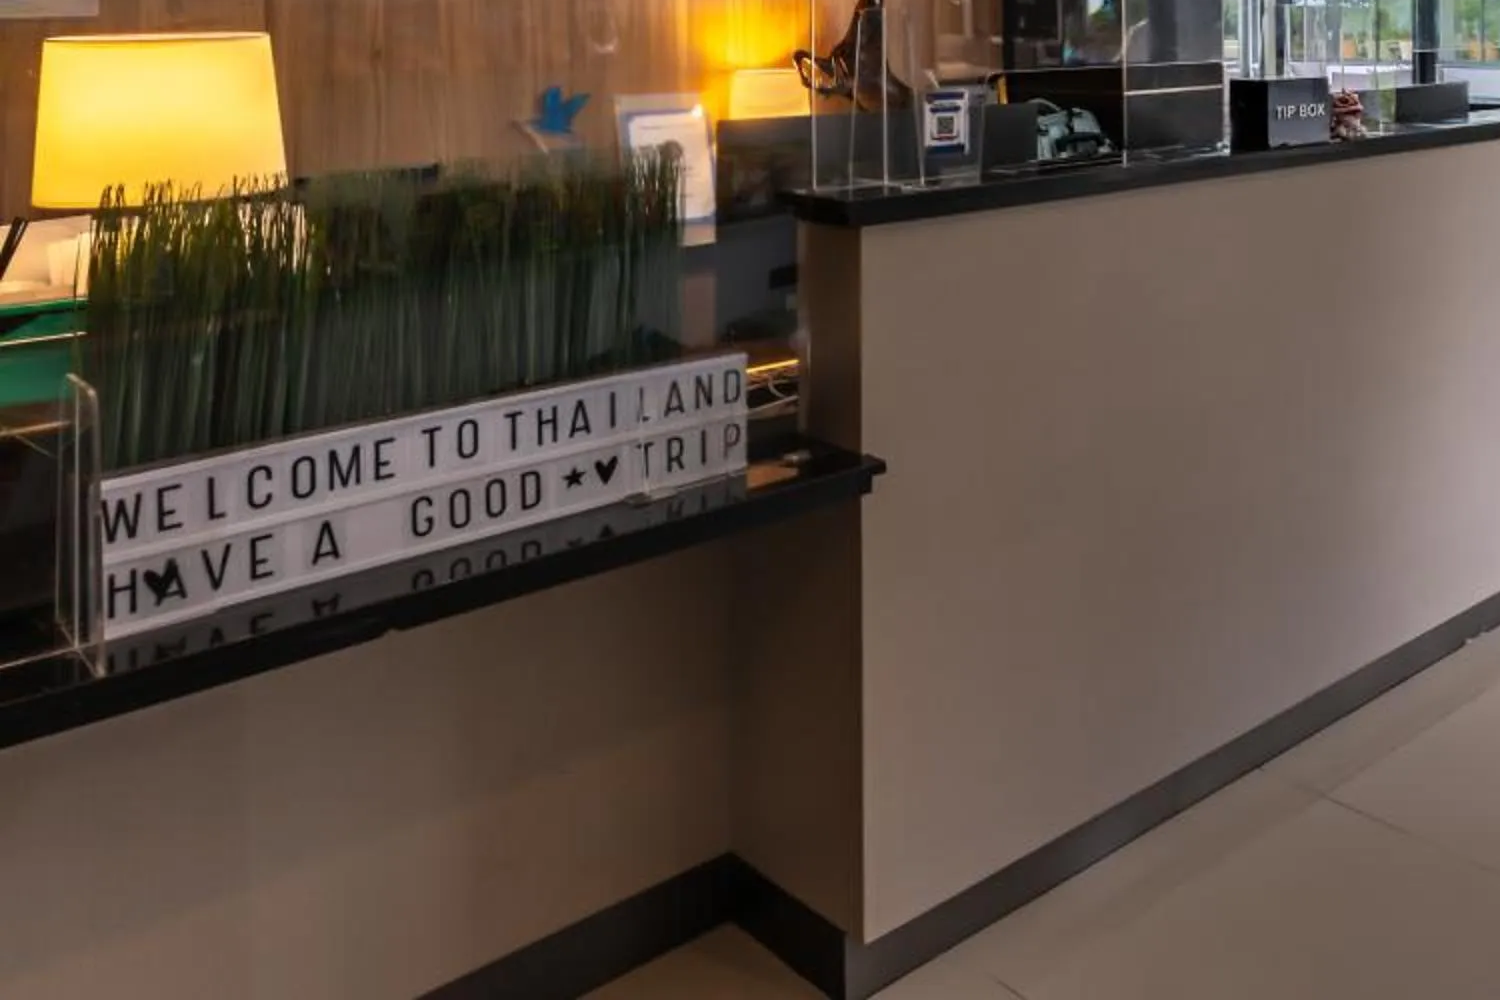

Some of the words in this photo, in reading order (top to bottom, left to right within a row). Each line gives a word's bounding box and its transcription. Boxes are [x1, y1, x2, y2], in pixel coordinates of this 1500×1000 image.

[1275, 104, 1297, 120] TIP
[1300, 102, 1326, 119] BOX
[102, 437, 396, 544] WELCOME
[421, 419, 480, 468] TO
[503, 368, 742, 451] THAILAND
[106, 533, 275, 619] HAVE
[311, 519, 341, 566] A
[411, 470, 542, 538] GOOD
[636, 422, 742, 480] TRIP
